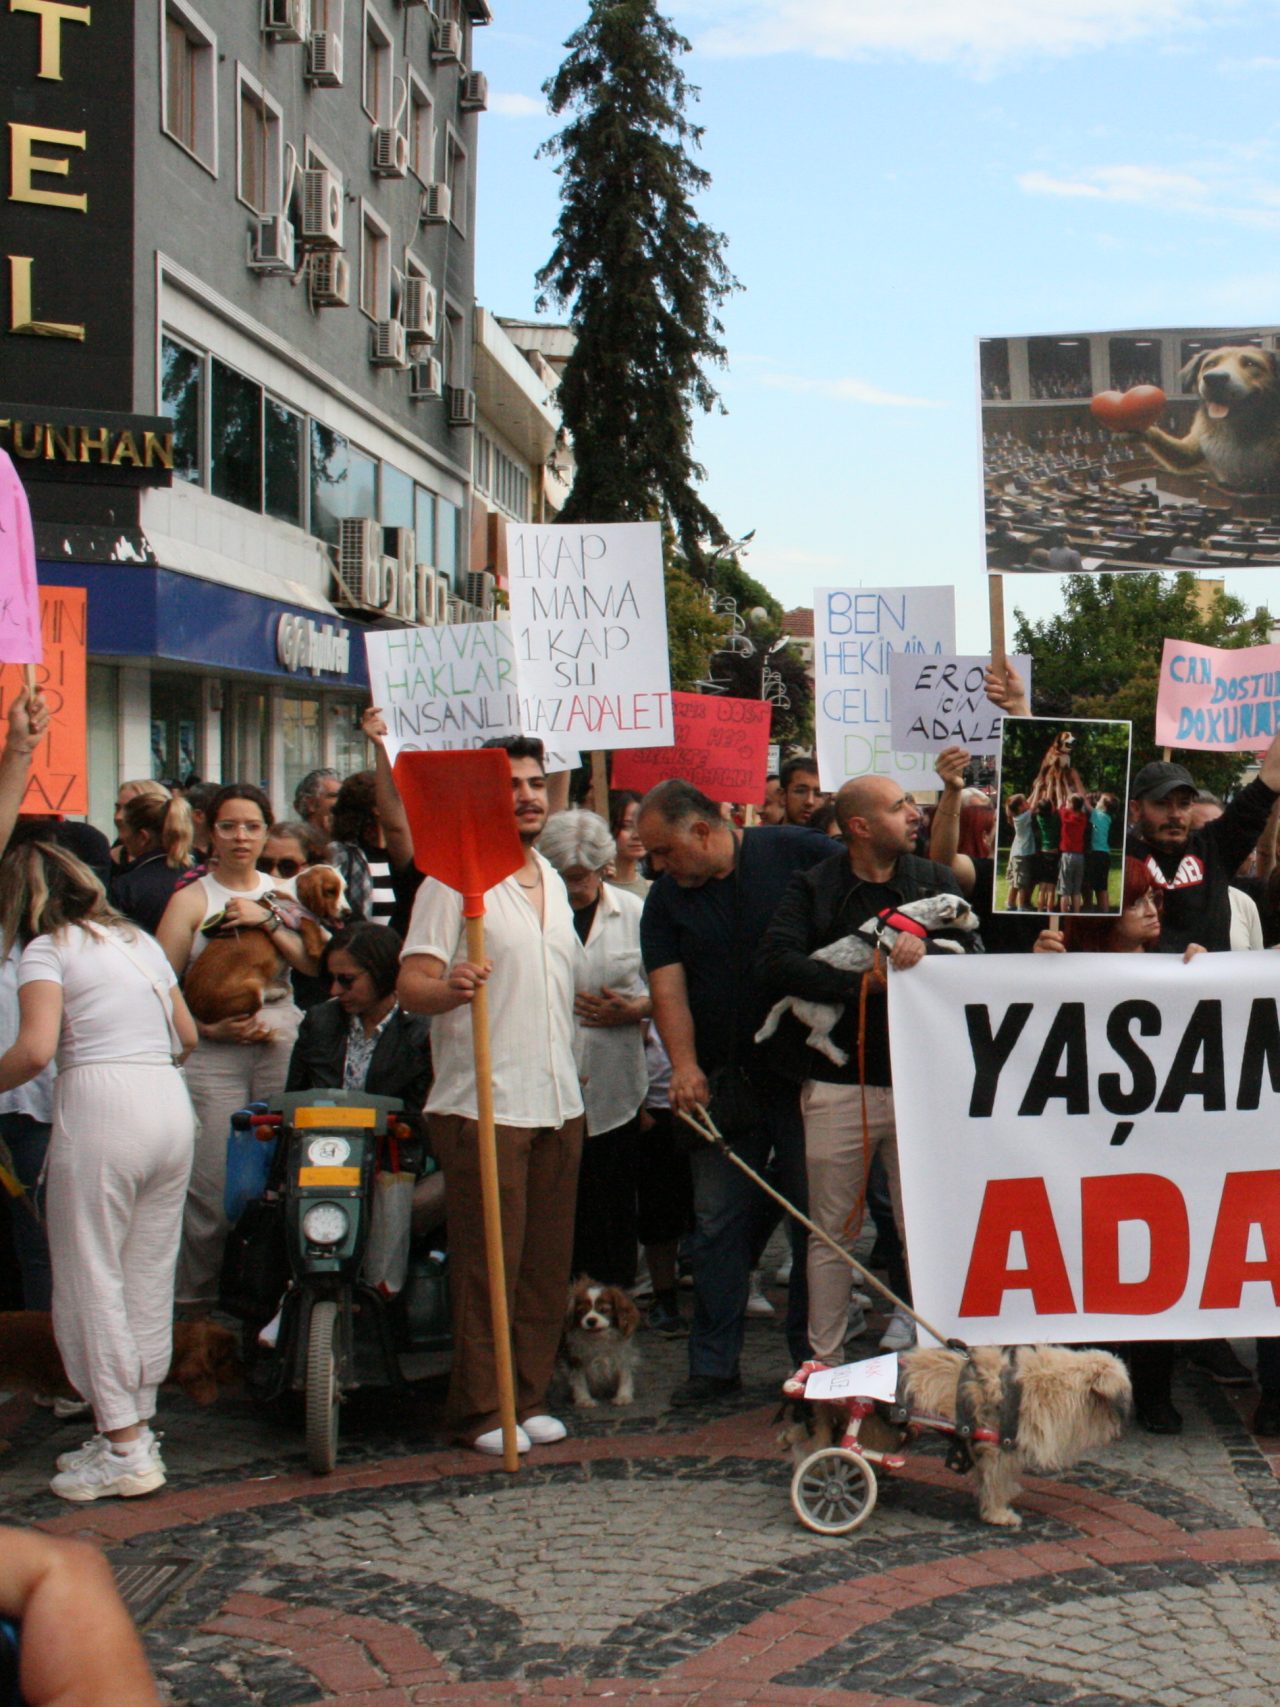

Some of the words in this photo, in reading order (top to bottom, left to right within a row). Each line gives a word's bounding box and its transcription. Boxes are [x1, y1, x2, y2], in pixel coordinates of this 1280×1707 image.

[0, 418, 174, 470] UNHAN
[827, 591, 906, 635] BEN
[386, 623, 514, 666] HAYVAN
[548, 626, 630, 661] KAP
[386, 658, 518, 701] HAKLAR
[555, 662, 596, 688] SU
[915, 664, 985, 692] ERO
[393, 694, 521, 737] İNSANLI
[566, 693, 669, 732] ADALET
[906, 716, 1002, 743] ADALE
